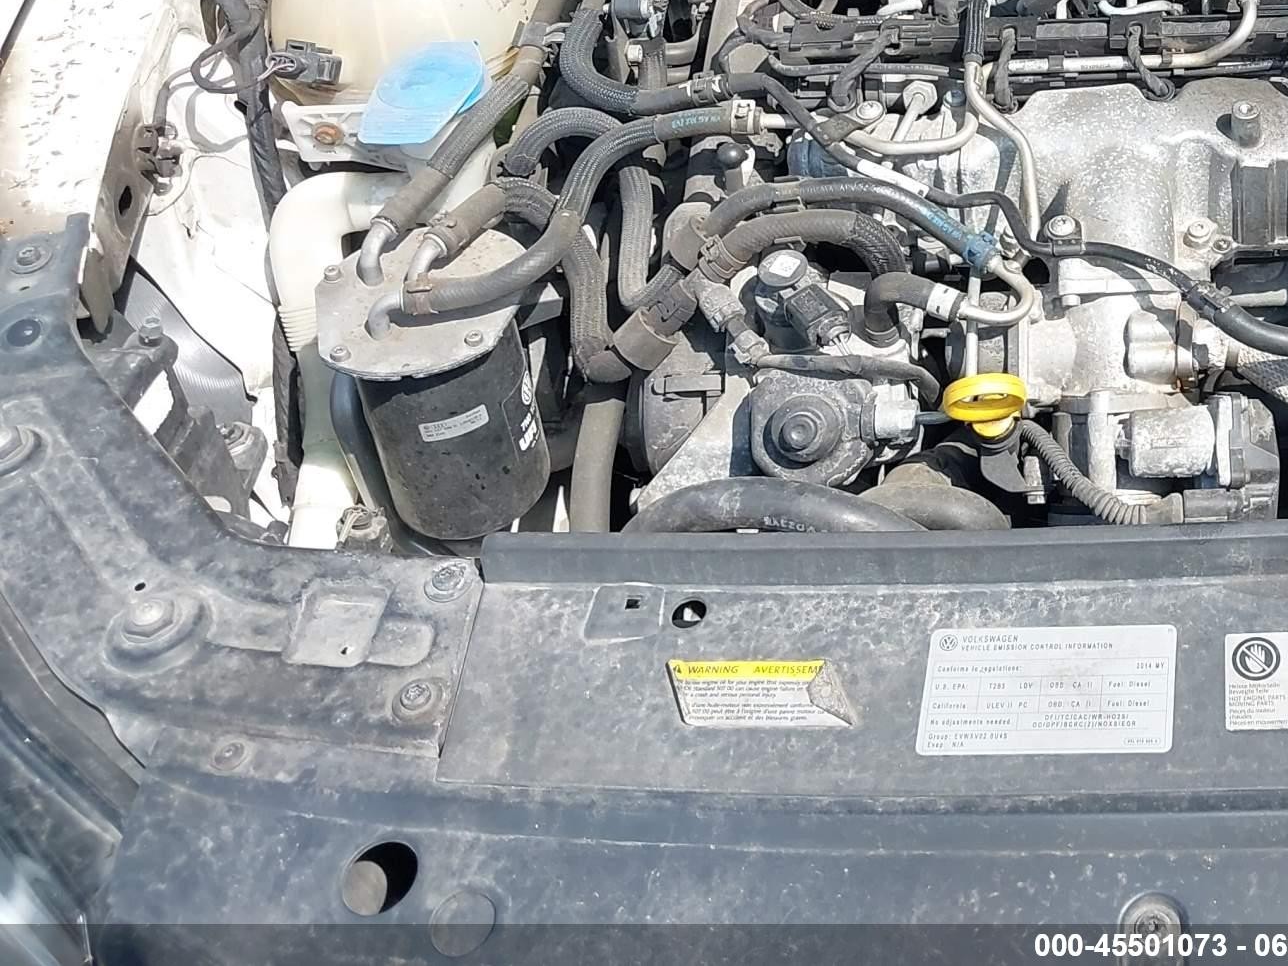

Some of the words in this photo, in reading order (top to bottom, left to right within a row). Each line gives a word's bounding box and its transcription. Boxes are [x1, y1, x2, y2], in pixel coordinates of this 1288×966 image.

[962, 634, 1019, 643] VOLKSWAGEN
[993, 643, 1027, 651] EMISSION
[688, 665, 739, 674] WARNING
